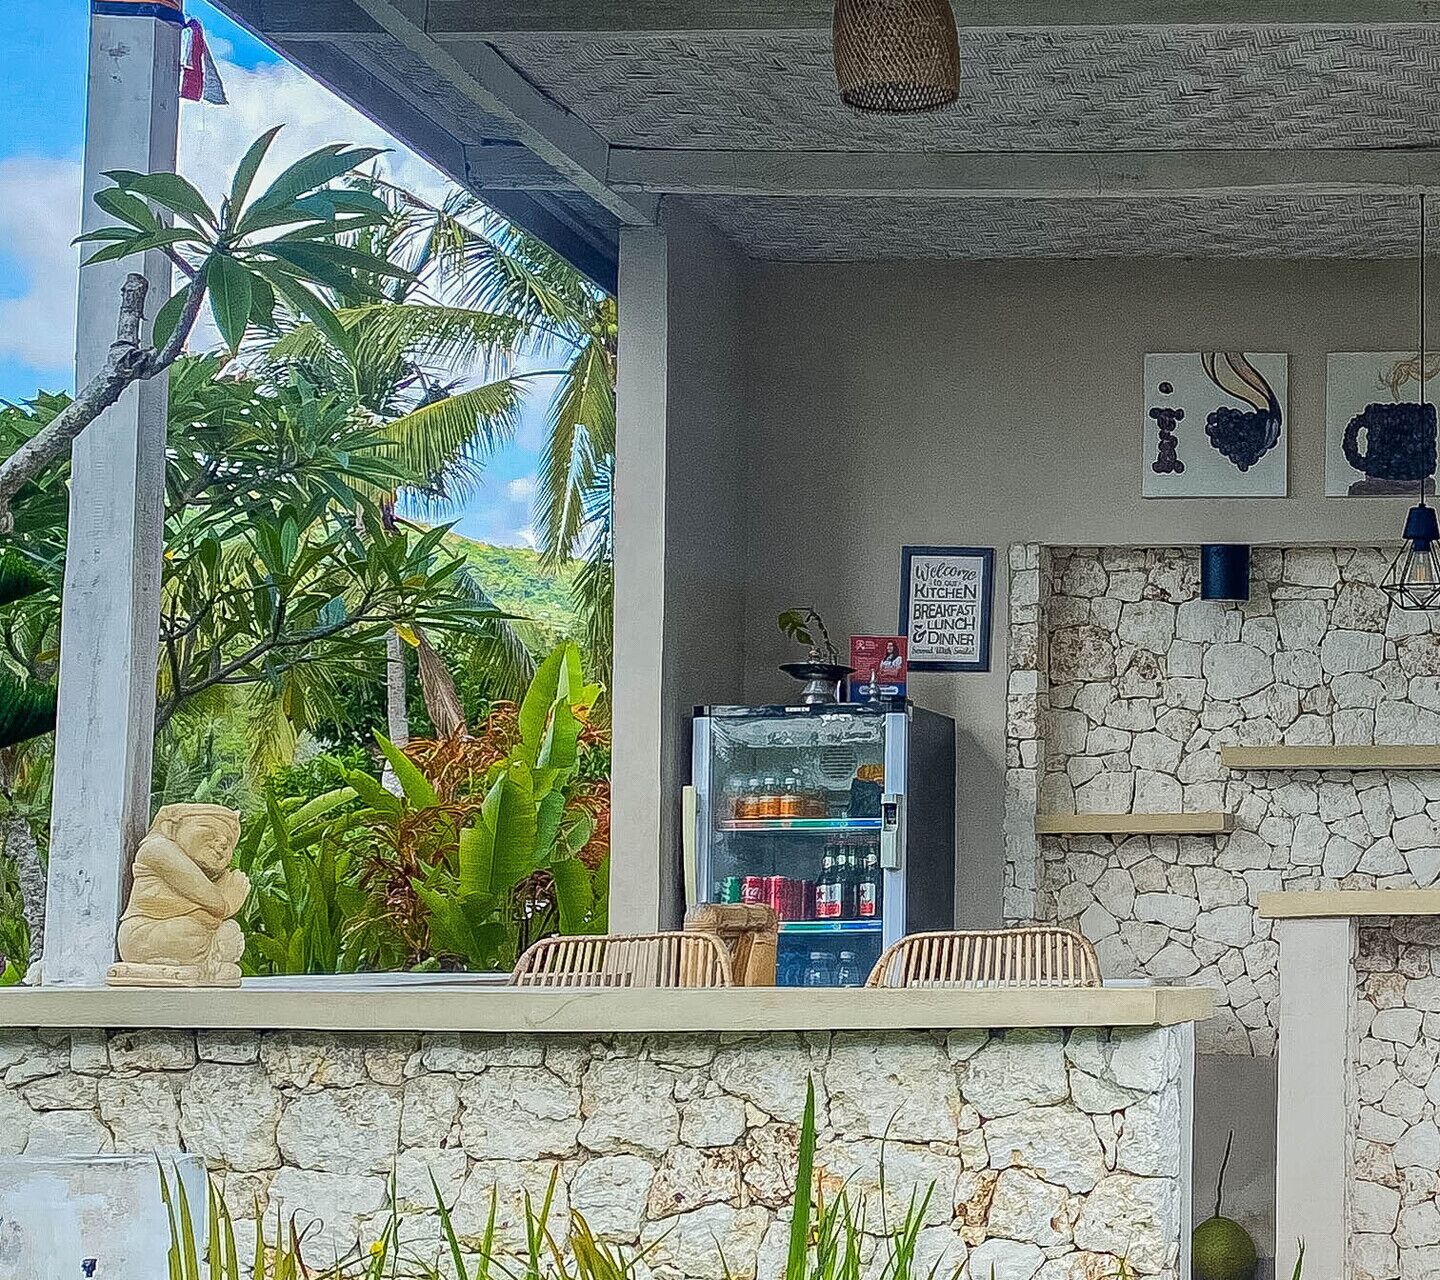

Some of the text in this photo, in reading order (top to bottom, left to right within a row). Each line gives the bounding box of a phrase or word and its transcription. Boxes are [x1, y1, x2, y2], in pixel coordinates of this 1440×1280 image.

[915, 562, 977, 582] Welcome
[914, 583, 977, 599] KITCHEN
[933, 579, 942, 587] to
[913, 603, 976, 620] BREAKFAST
[927, 617, 975, 631] LUNCH
[912, 624, 975, 646] & DINNER
